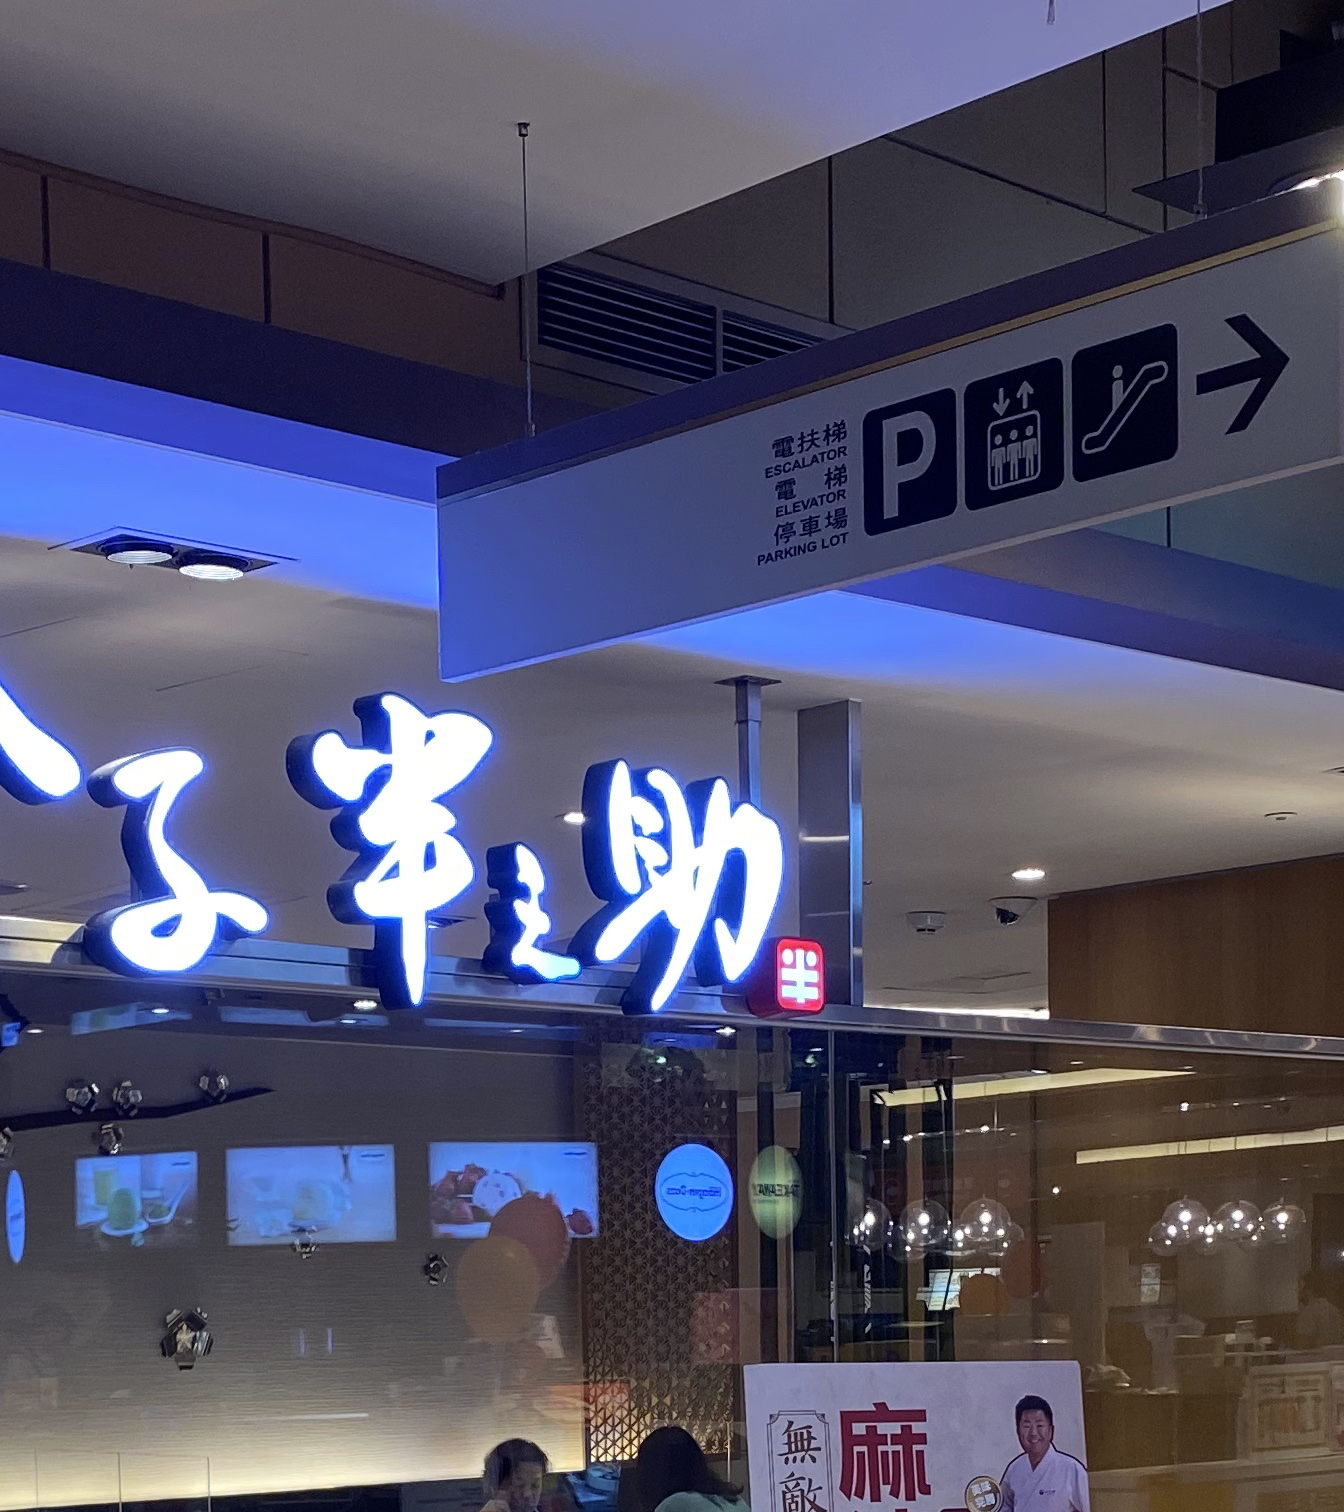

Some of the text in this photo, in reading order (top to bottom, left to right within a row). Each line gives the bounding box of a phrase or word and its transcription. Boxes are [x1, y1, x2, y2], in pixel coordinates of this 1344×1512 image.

[772, 419, 848, 459] 電扶梯
[764, 446, 848, 479] ESCALATOR
[882, 410, 937, 520] P
[775, 488, 847, 518] ELEVATOR
[773, 507, 849, 546] 停車場
[757, 532, 849, 566] PARKING LOT
